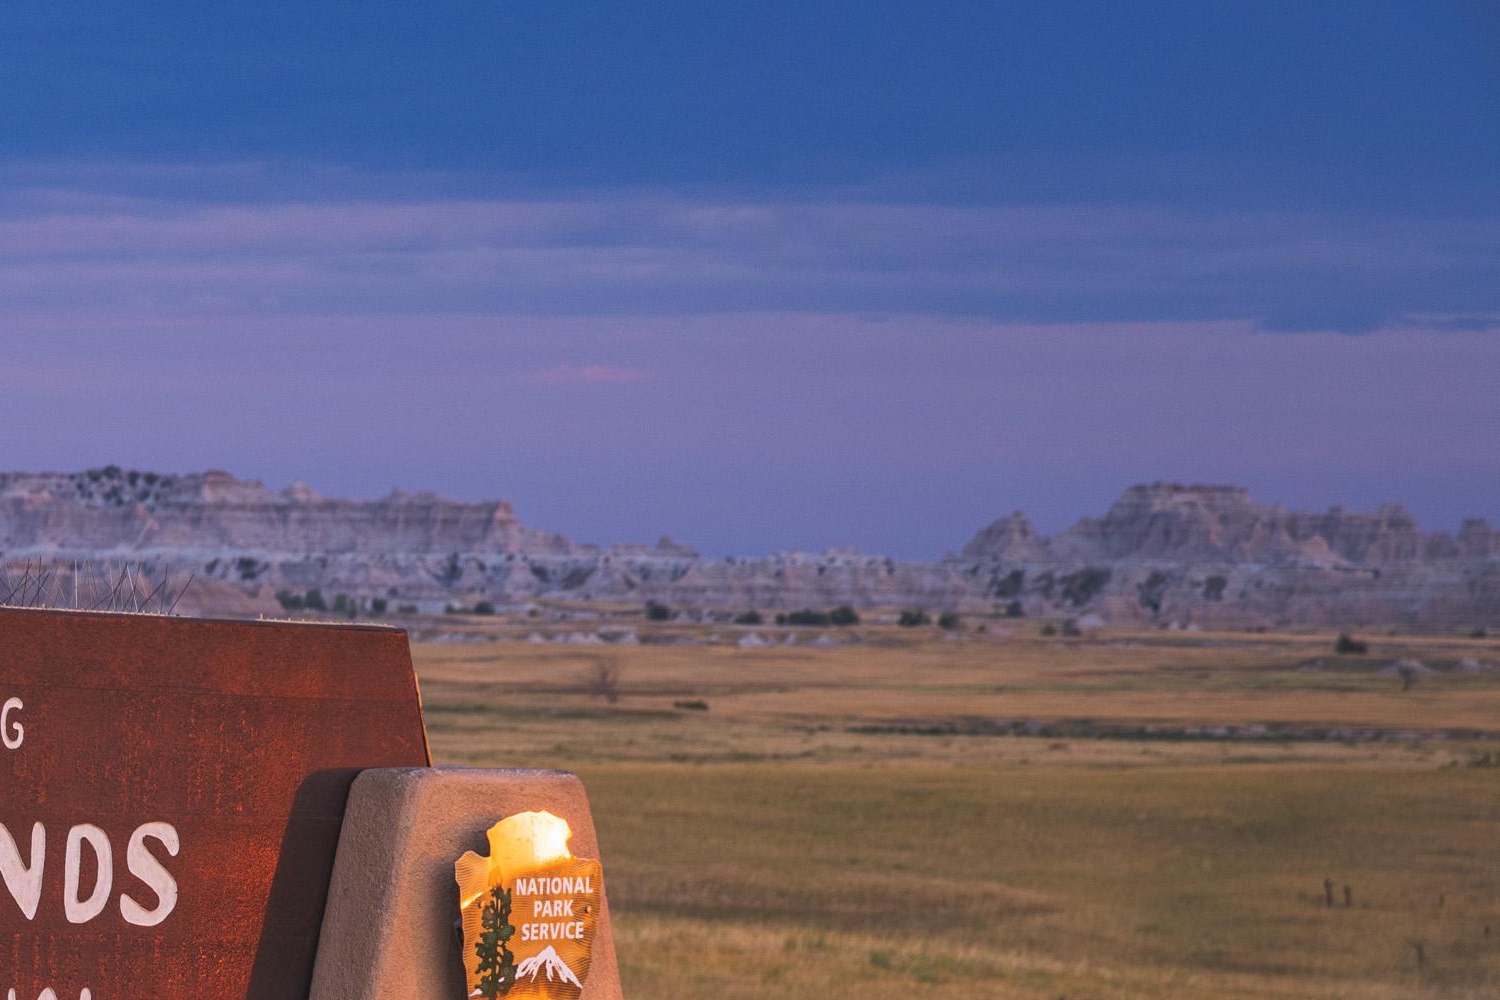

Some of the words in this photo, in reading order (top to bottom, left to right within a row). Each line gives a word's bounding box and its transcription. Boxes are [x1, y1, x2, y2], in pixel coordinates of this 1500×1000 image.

[516, 876, 593, 896] NATIONAL
[533, 899, 574, 917] PARK
[521, 921, 584, 941] SERVICE
